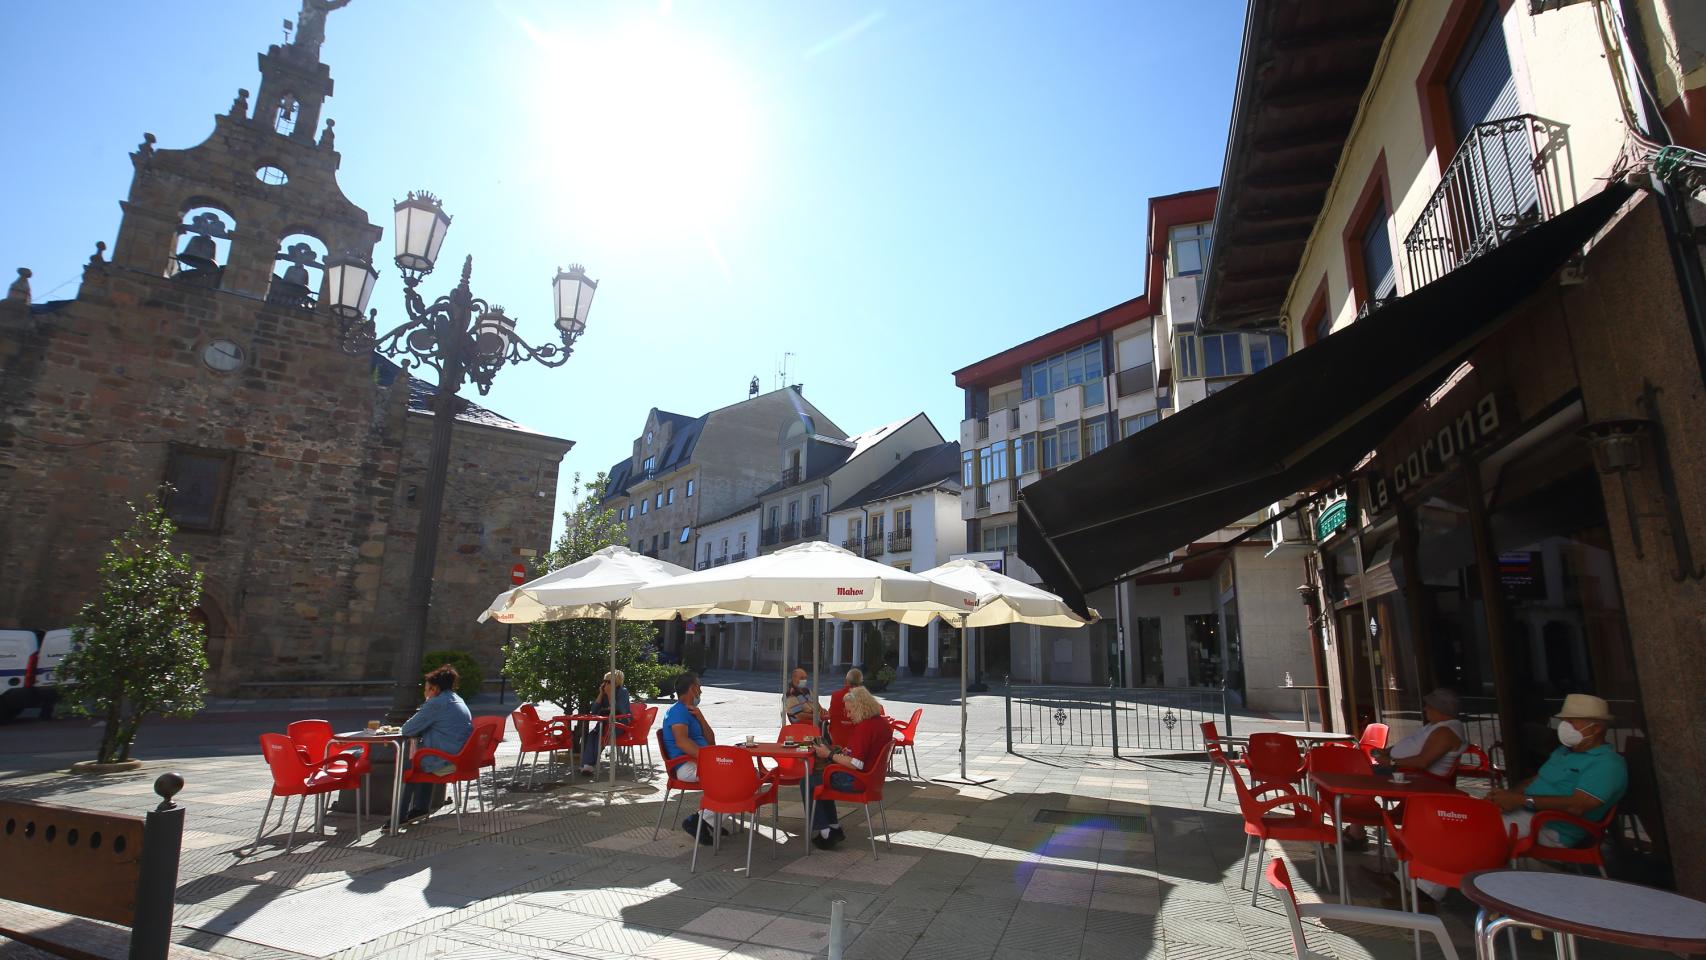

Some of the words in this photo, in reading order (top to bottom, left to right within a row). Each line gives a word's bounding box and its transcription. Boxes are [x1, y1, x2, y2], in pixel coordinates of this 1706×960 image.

[1367, 477, 1388, 513] La
[1394, 391, 1500, 494] corona
[836, 587, 864, 596] Mahou
[1437, 810, 1468, 819] Mahou
